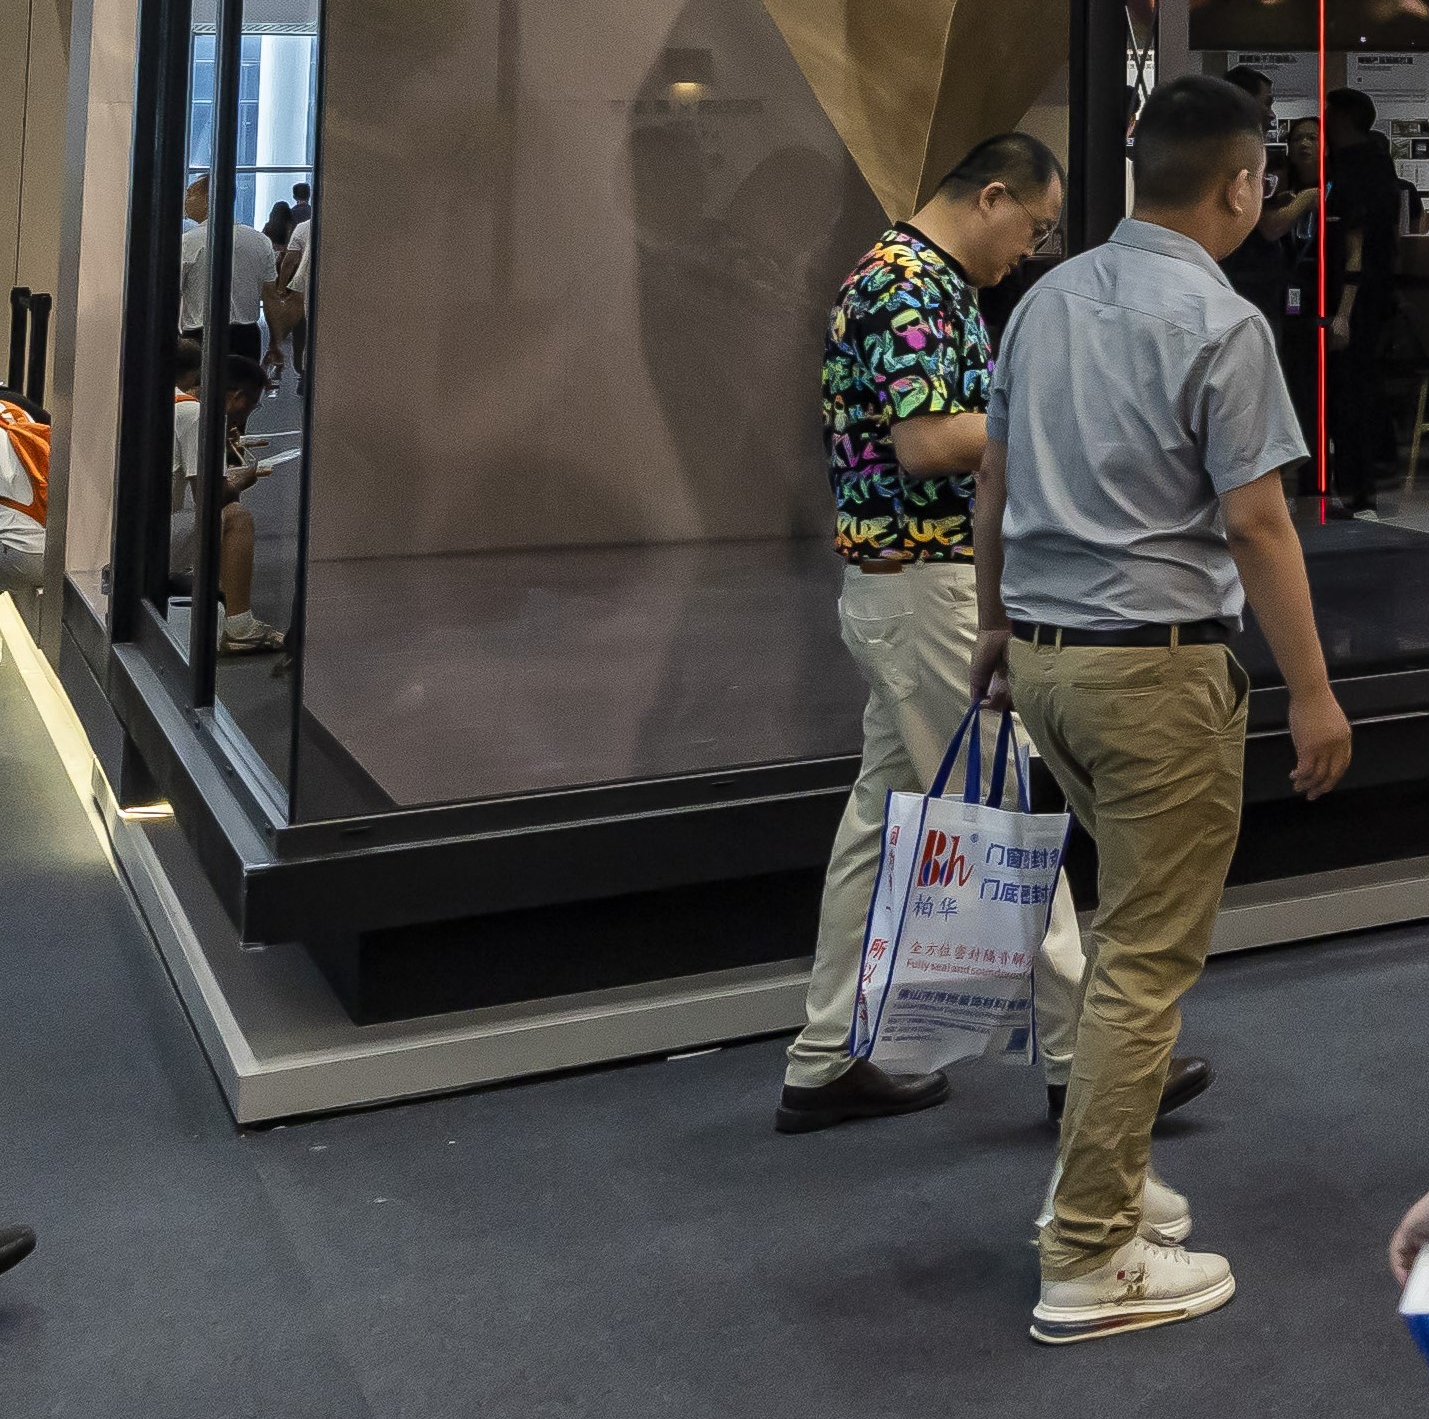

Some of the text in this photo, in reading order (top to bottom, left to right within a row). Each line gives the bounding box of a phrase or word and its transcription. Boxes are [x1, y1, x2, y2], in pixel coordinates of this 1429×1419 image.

[978, 877, 1052, 905] 门底密封
[912, 893, 959, 922] 柏华
[906, 957, 930, 972] Fully
